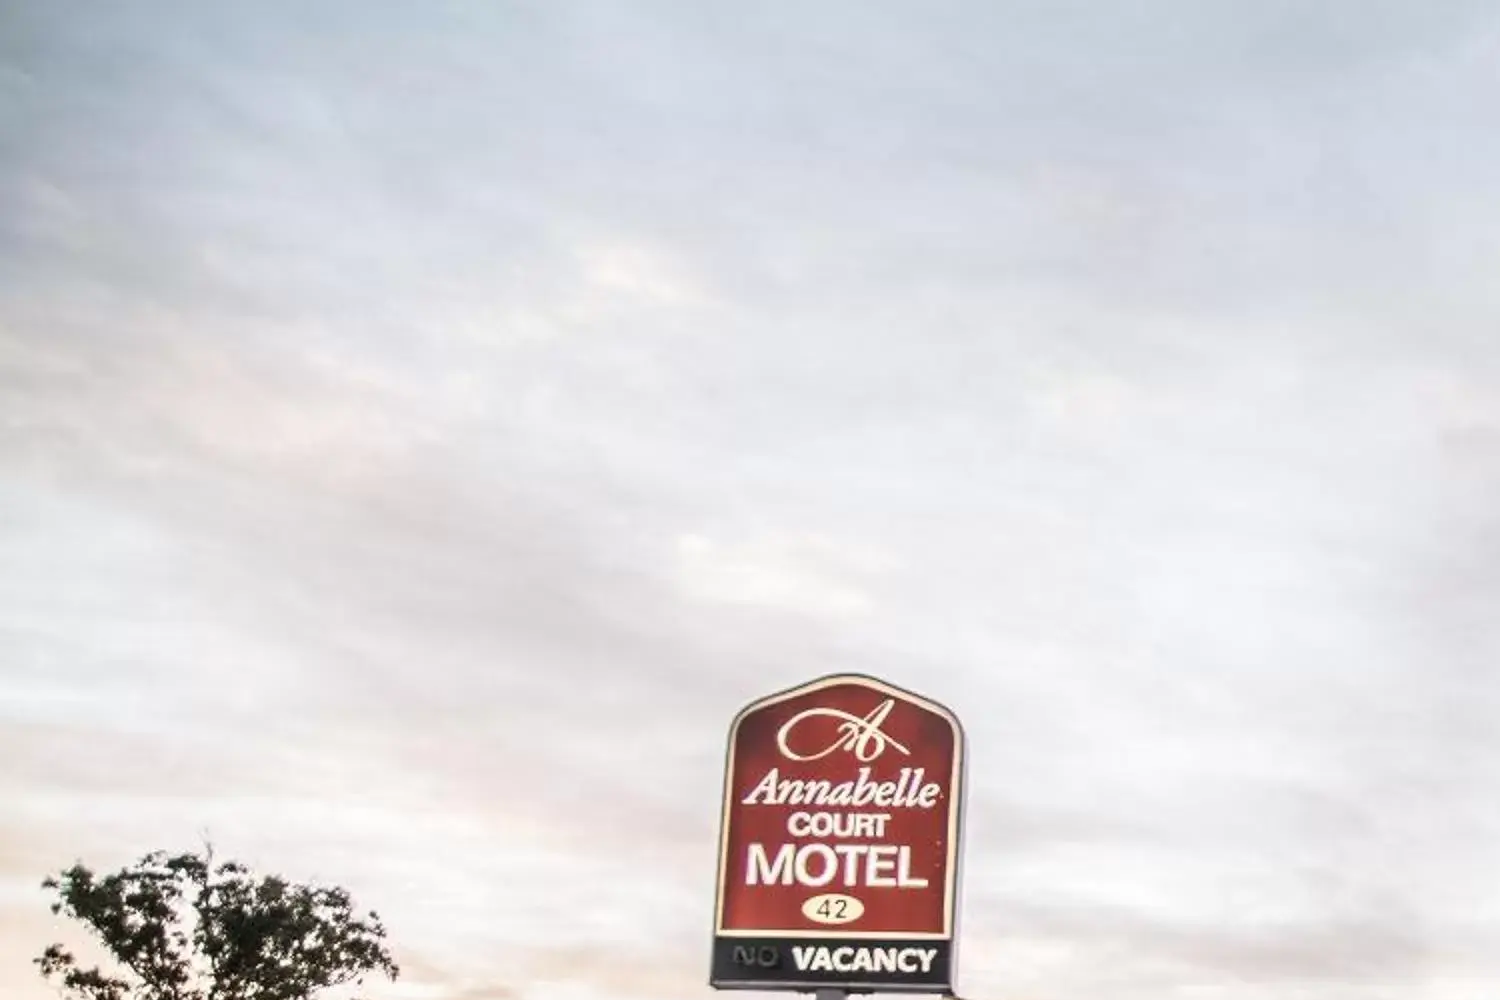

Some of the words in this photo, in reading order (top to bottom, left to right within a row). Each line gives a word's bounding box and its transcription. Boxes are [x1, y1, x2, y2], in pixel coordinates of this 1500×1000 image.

[742, 767, 941, 808] Annabelle
[787, 811, 892, 837] COURT
[745, 843, 929, 888] MOTEL
[816, 899, 848, 919] 42
[732, 945, 779, 968] NO
[791, 946, 938, 973] VACANCY
